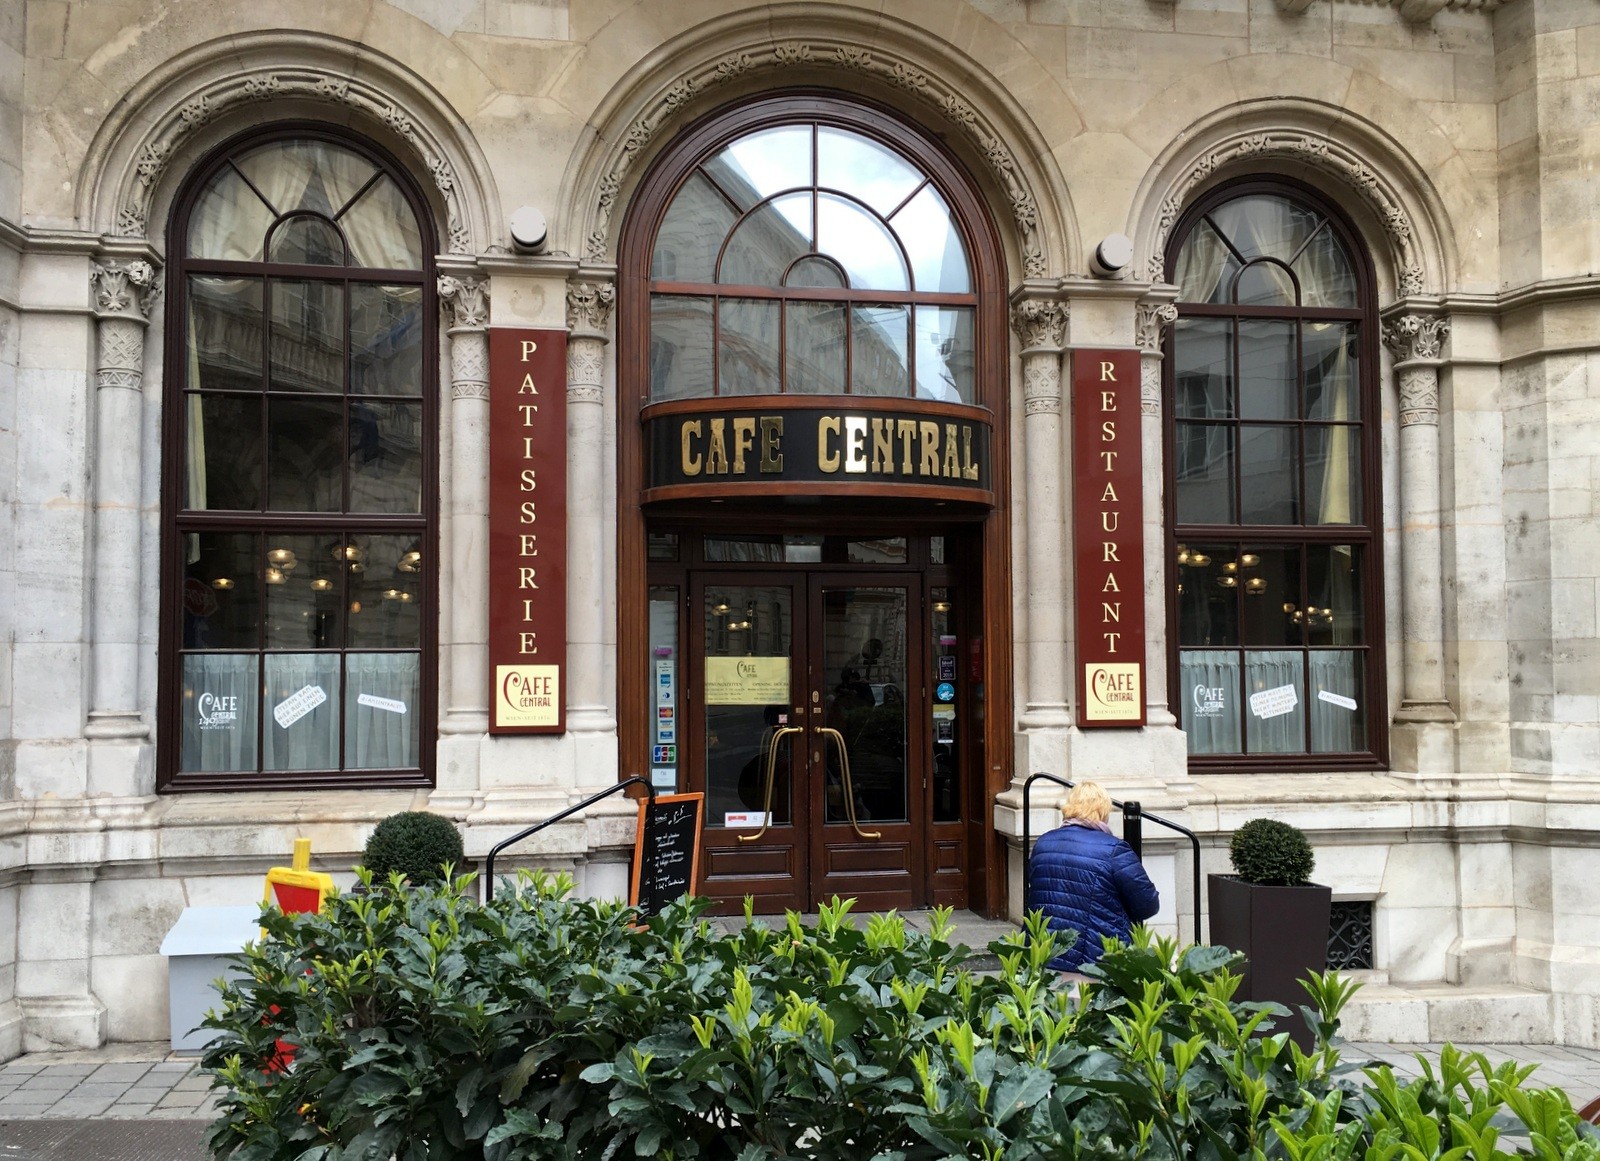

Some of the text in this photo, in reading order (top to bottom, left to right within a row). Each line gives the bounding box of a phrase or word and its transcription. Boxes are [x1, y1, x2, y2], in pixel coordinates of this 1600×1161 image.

[681, 416, 979, 481] CAFE CENTRAL
[517, 340, 539, 654] PATISSERIE
[1100, 361, 1121, 653] RESTAURANT
[198, 692, 238, 721] CAFE
[503, 671, 552, 712] CAFE
[520, 697, 552, 708] CENTRAL
[1092, 668, 1134, 707] CAFE
[1106, 692, 1135, 702] CENTRAL
[1193, 684, 1225, 709] CAFE
